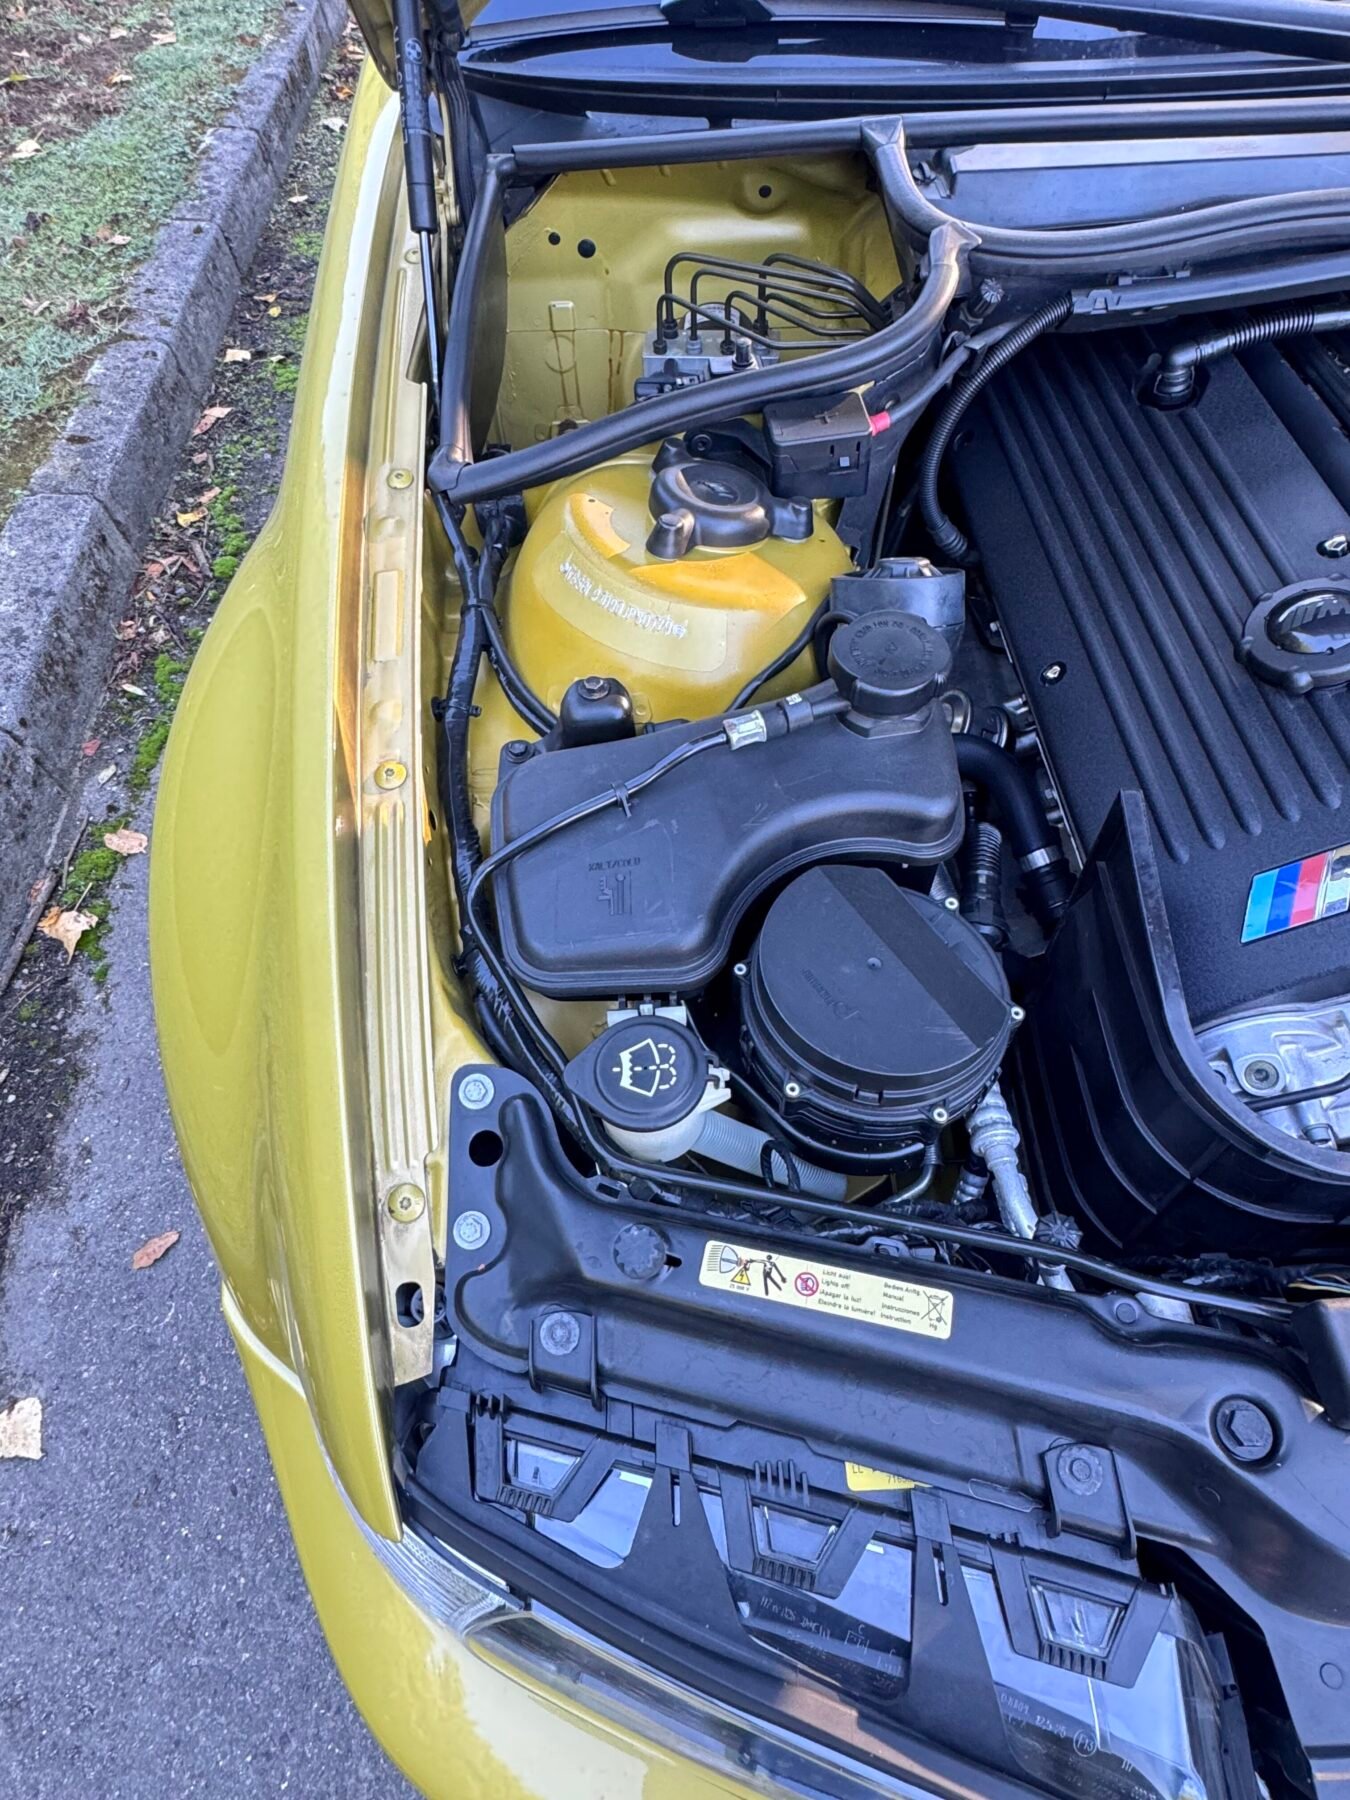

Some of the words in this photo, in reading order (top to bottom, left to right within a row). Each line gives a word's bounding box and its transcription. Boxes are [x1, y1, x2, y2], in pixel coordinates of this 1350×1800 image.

[822, 1269, 837, 1277] Licht
[821, 1278, 839, 1287] Lights
[882, 1292, 904, 1301] Manual
[881, 1302, 920, 1316] Instrucciones
[929, 1322, 938, 1331] Hg
